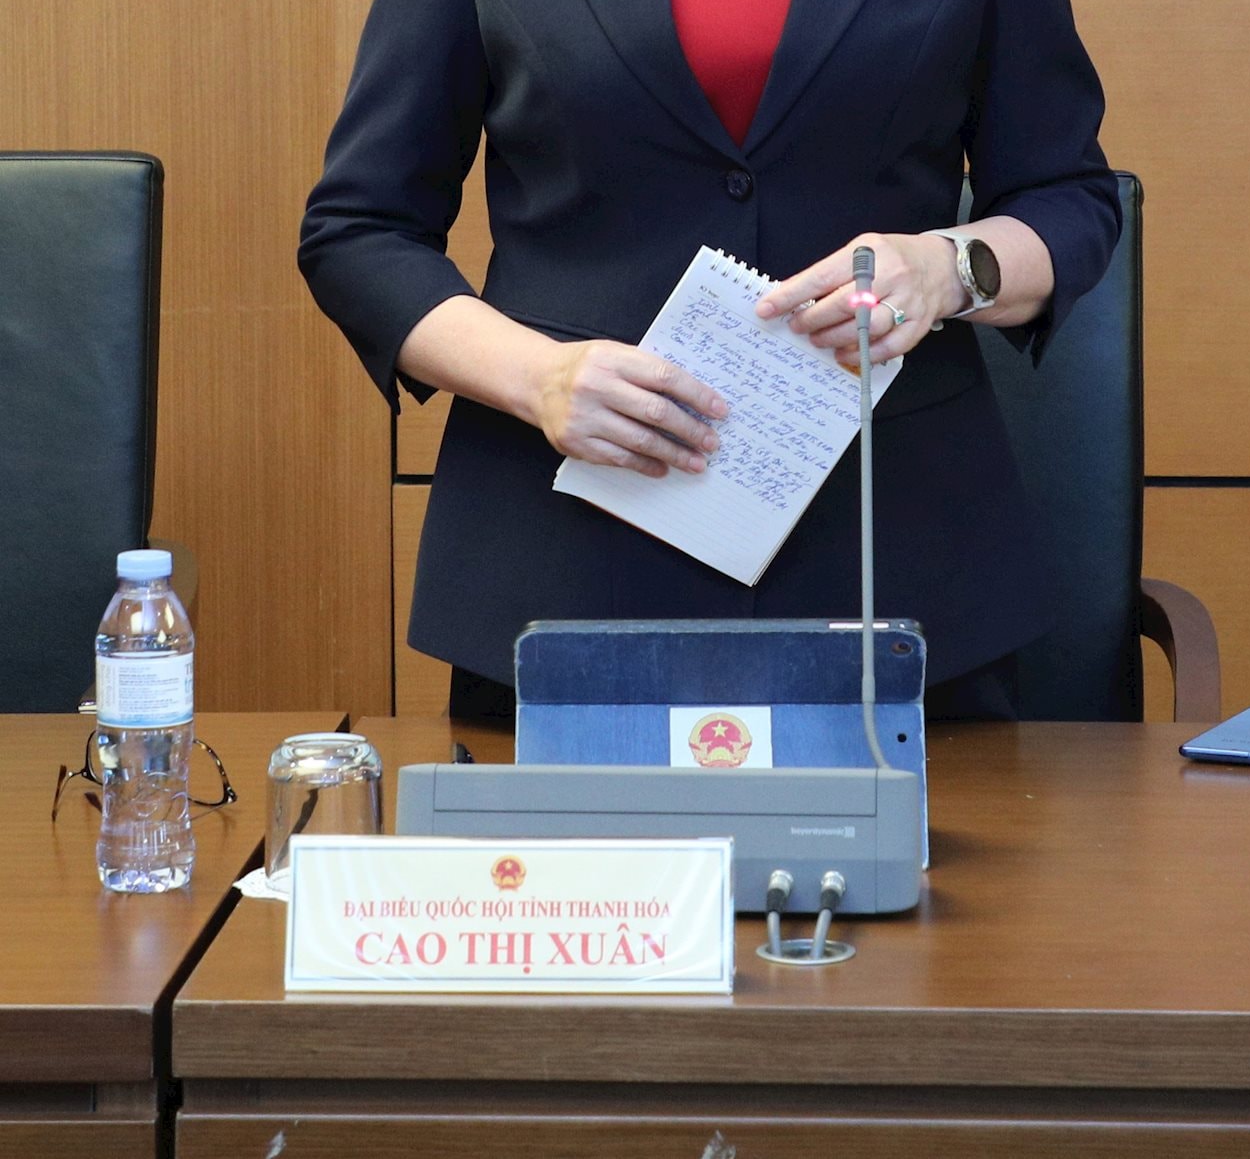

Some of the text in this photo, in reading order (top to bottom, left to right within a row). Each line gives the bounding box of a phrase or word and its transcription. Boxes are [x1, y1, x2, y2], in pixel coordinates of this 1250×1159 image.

[344, 900, 375, 922] ĐẠI
[425, 896, 477, 921] QUỐC
[481, 898, 514, 922] HỘI
[519, 896, 562, 918] TỈNH
[567, 900, 629, 918] THANH
[634, 896, 671, 918] HÓA
[354, 922, 668, 975] CAO THỊ XUÂN
